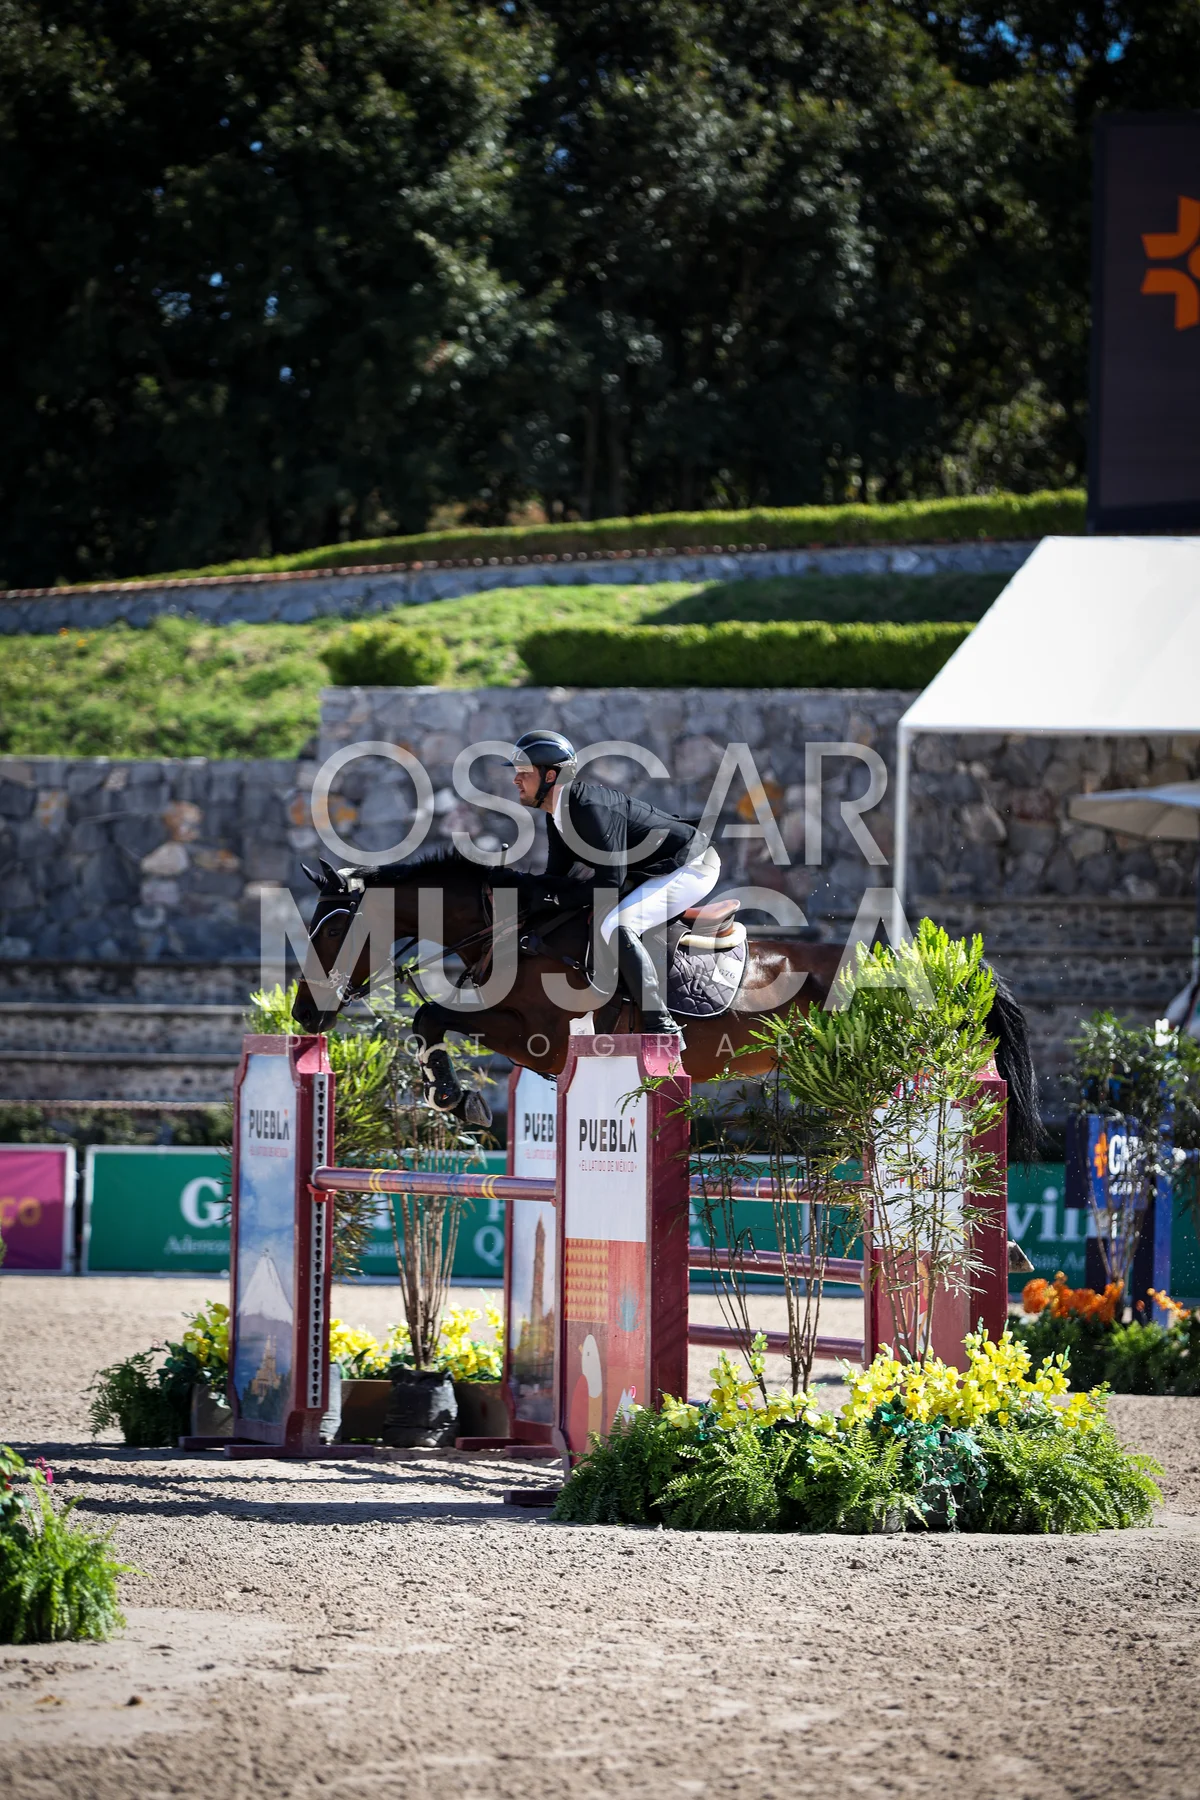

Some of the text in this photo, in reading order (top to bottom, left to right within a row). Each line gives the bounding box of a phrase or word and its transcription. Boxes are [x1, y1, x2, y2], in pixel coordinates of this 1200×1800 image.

[248, 1108, 290, 1140] PUEBLA
[524, 1112, 554, 1142] PUEB
[579, 1117, 637, 1153] PUEBLA
[588, 1160, 606, 1172] LATIDO
[607, 1160, 614, 1172] DE
